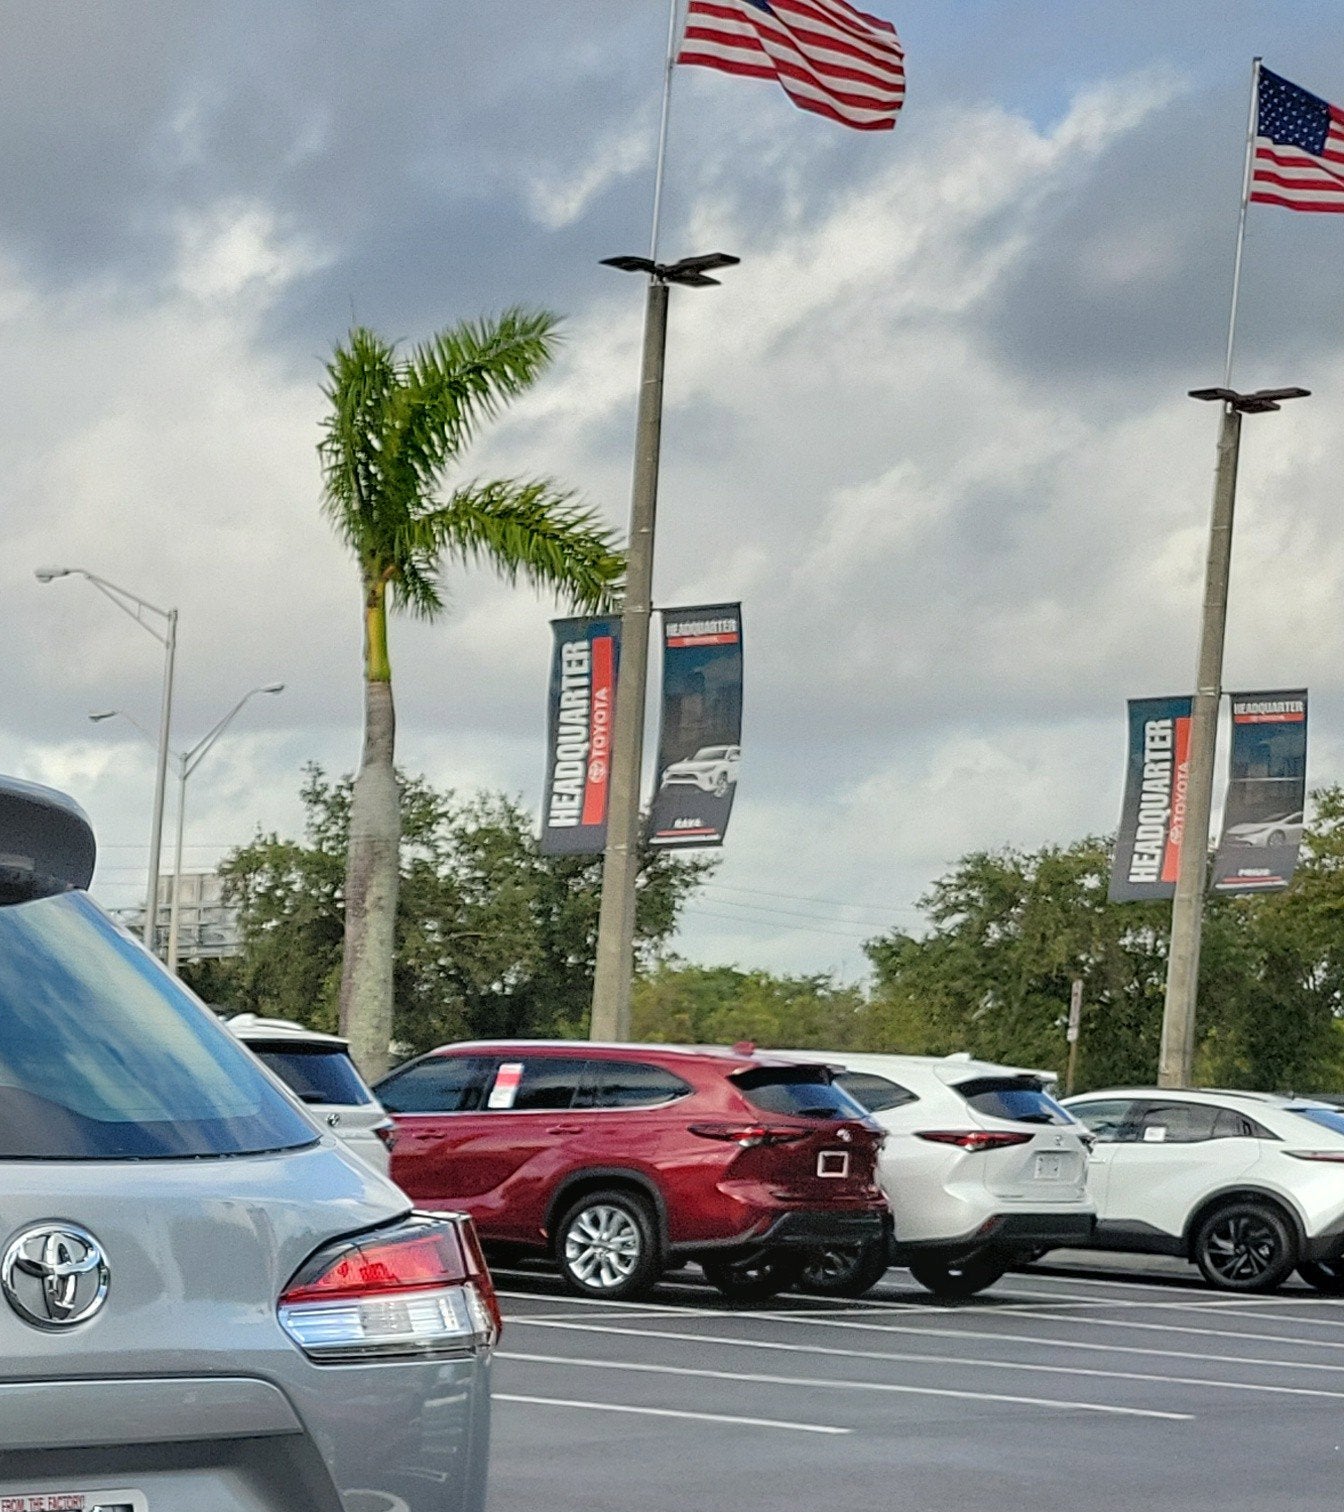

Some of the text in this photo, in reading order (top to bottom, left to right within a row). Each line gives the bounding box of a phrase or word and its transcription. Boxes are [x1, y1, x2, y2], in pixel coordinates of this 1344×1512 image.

[548, 638, 591, 828] HEADQUARTER
[591, 686, 610, 759] TOYOTA
[1234, 701, 1304, 715] HEADQUARTER
[1128, 719, 1173, 883] HEADQUARTER
[1173, 762, 1189, 825] TOYOTA
